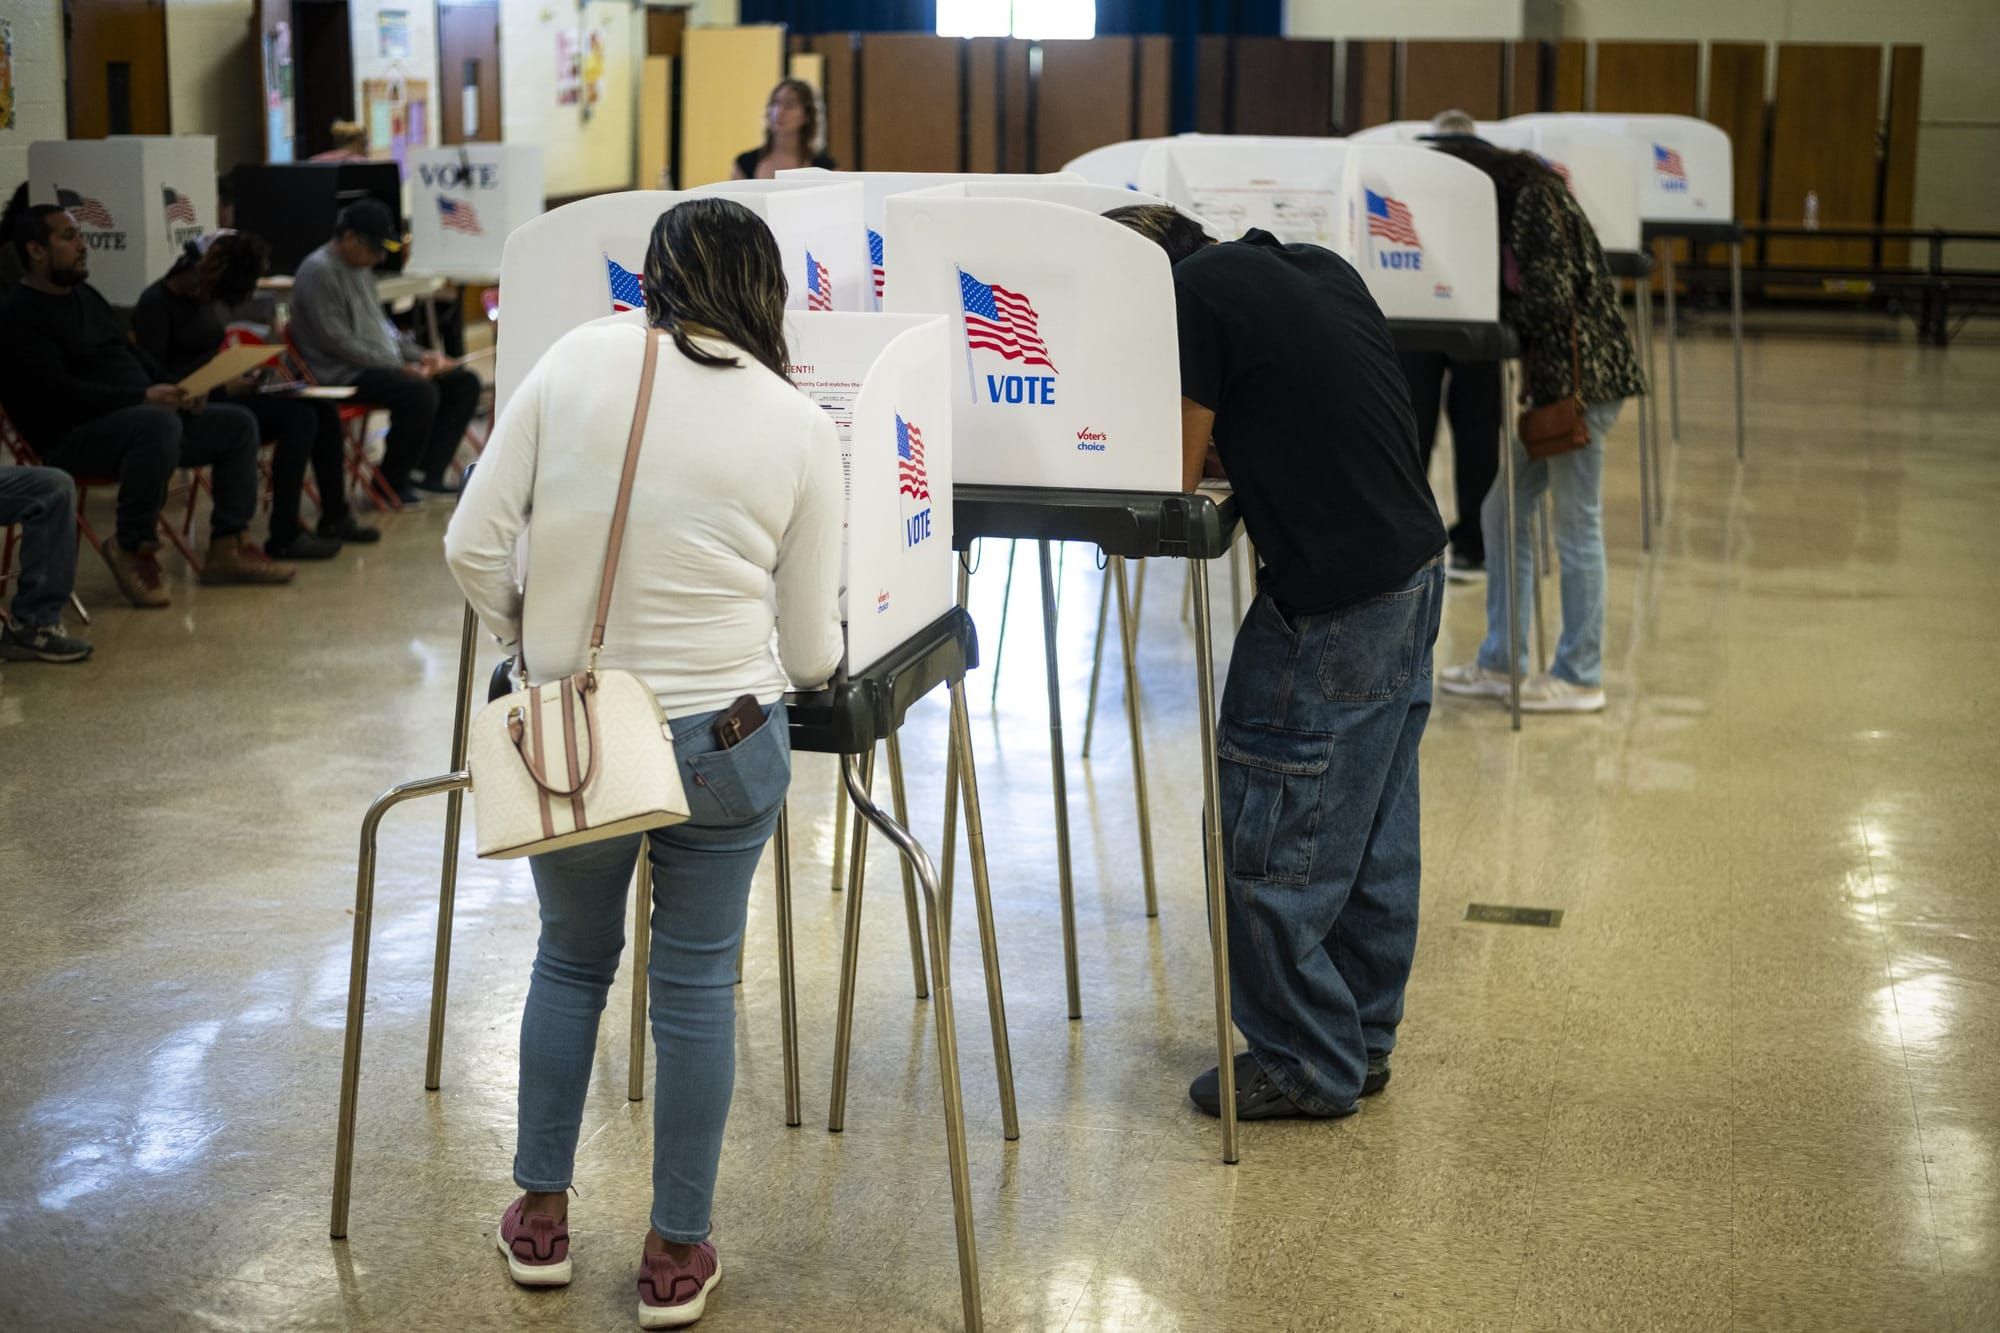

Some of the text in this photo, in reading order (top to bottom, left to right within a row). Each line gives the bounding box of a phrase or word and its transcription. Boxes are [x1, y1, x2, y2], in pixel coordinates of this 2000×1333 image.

[1379, 250, 1423, 270] VOTE
[784, 365, 814, 374] GENT!!
[986, 374, 1056, 405] VOTE
[1077, 426, 1107, 441] Voter's
[1077, 441, 1106, 452] choice
[906, 507, 931, 548] VOTE
